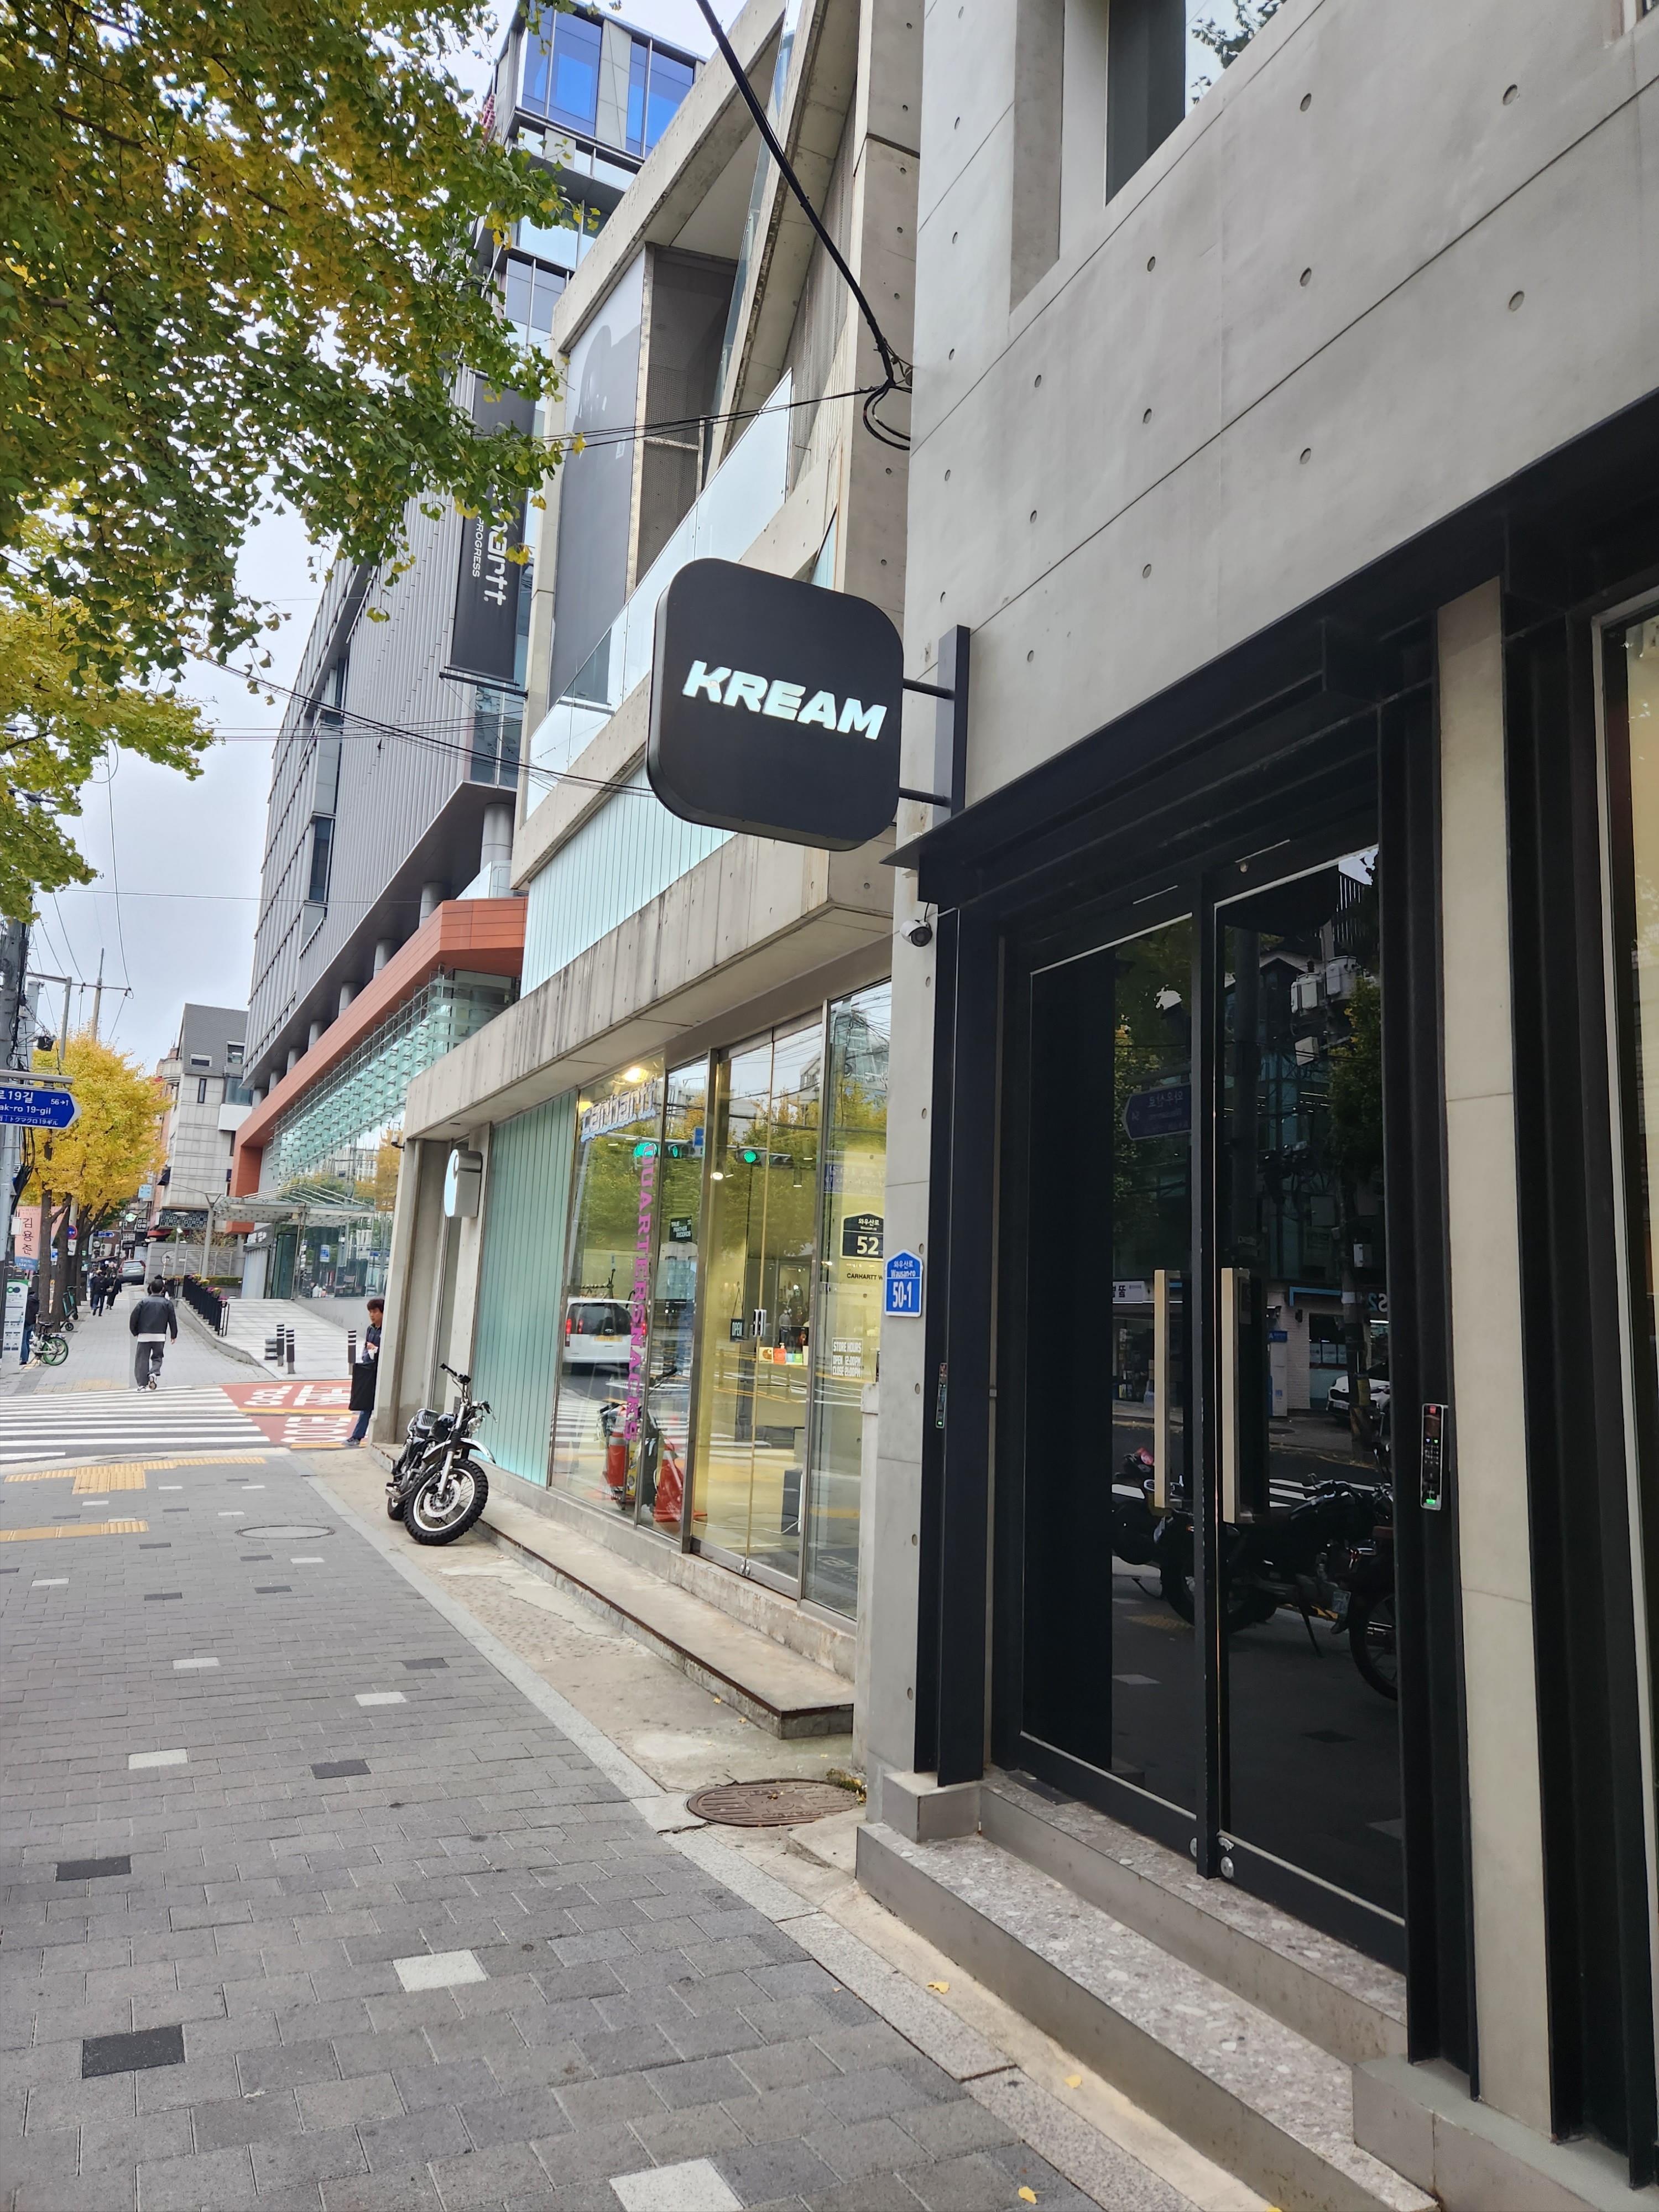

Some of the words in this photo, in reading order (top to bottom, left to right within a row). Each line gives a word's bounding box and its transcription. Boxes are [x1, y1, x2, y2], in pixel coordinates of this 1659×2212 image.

[681, 660, 888, 741] KREAM
[26, 1105, 51, 1115] 19-gil
[857, 1235, 879, 1255] 52
[893, 1260, 914, 1269] 와우산로
[892, 1281, 912, 1308] 50-1
[732, 1322, 743, 1337] OPEN
[833, 1342, 847, 1352] STORE
[847, 1342, 862, 1353] HOURS
[833, 1355, 843, 1365] OPEN
[832, 1366, 844, 1376] CLOSE
